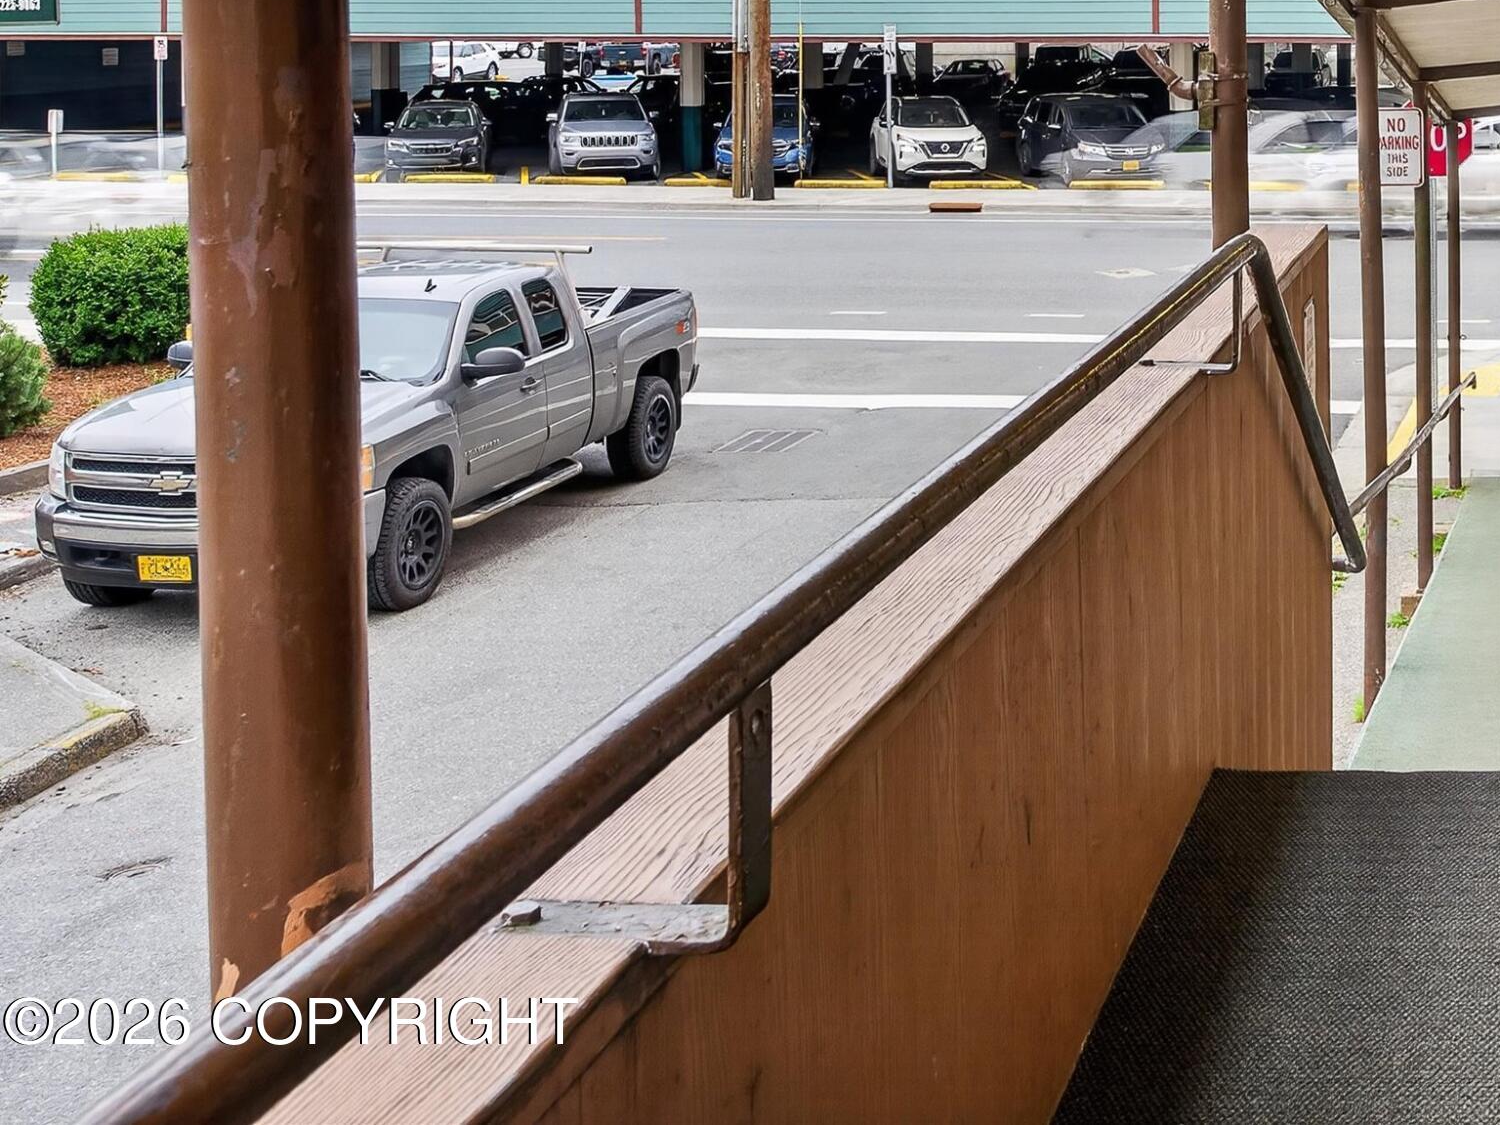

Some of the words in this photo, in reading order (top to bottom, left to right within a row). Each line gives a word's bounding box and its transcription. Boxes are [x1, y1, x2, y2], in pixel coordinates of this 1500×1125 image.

[1387, 118, 1406, 132] NO
[1380, 135, 1419, 150] ARKING
[1387, 154, 1408, 164] THIS
[1386, 167, 1409, 177] SIDE
